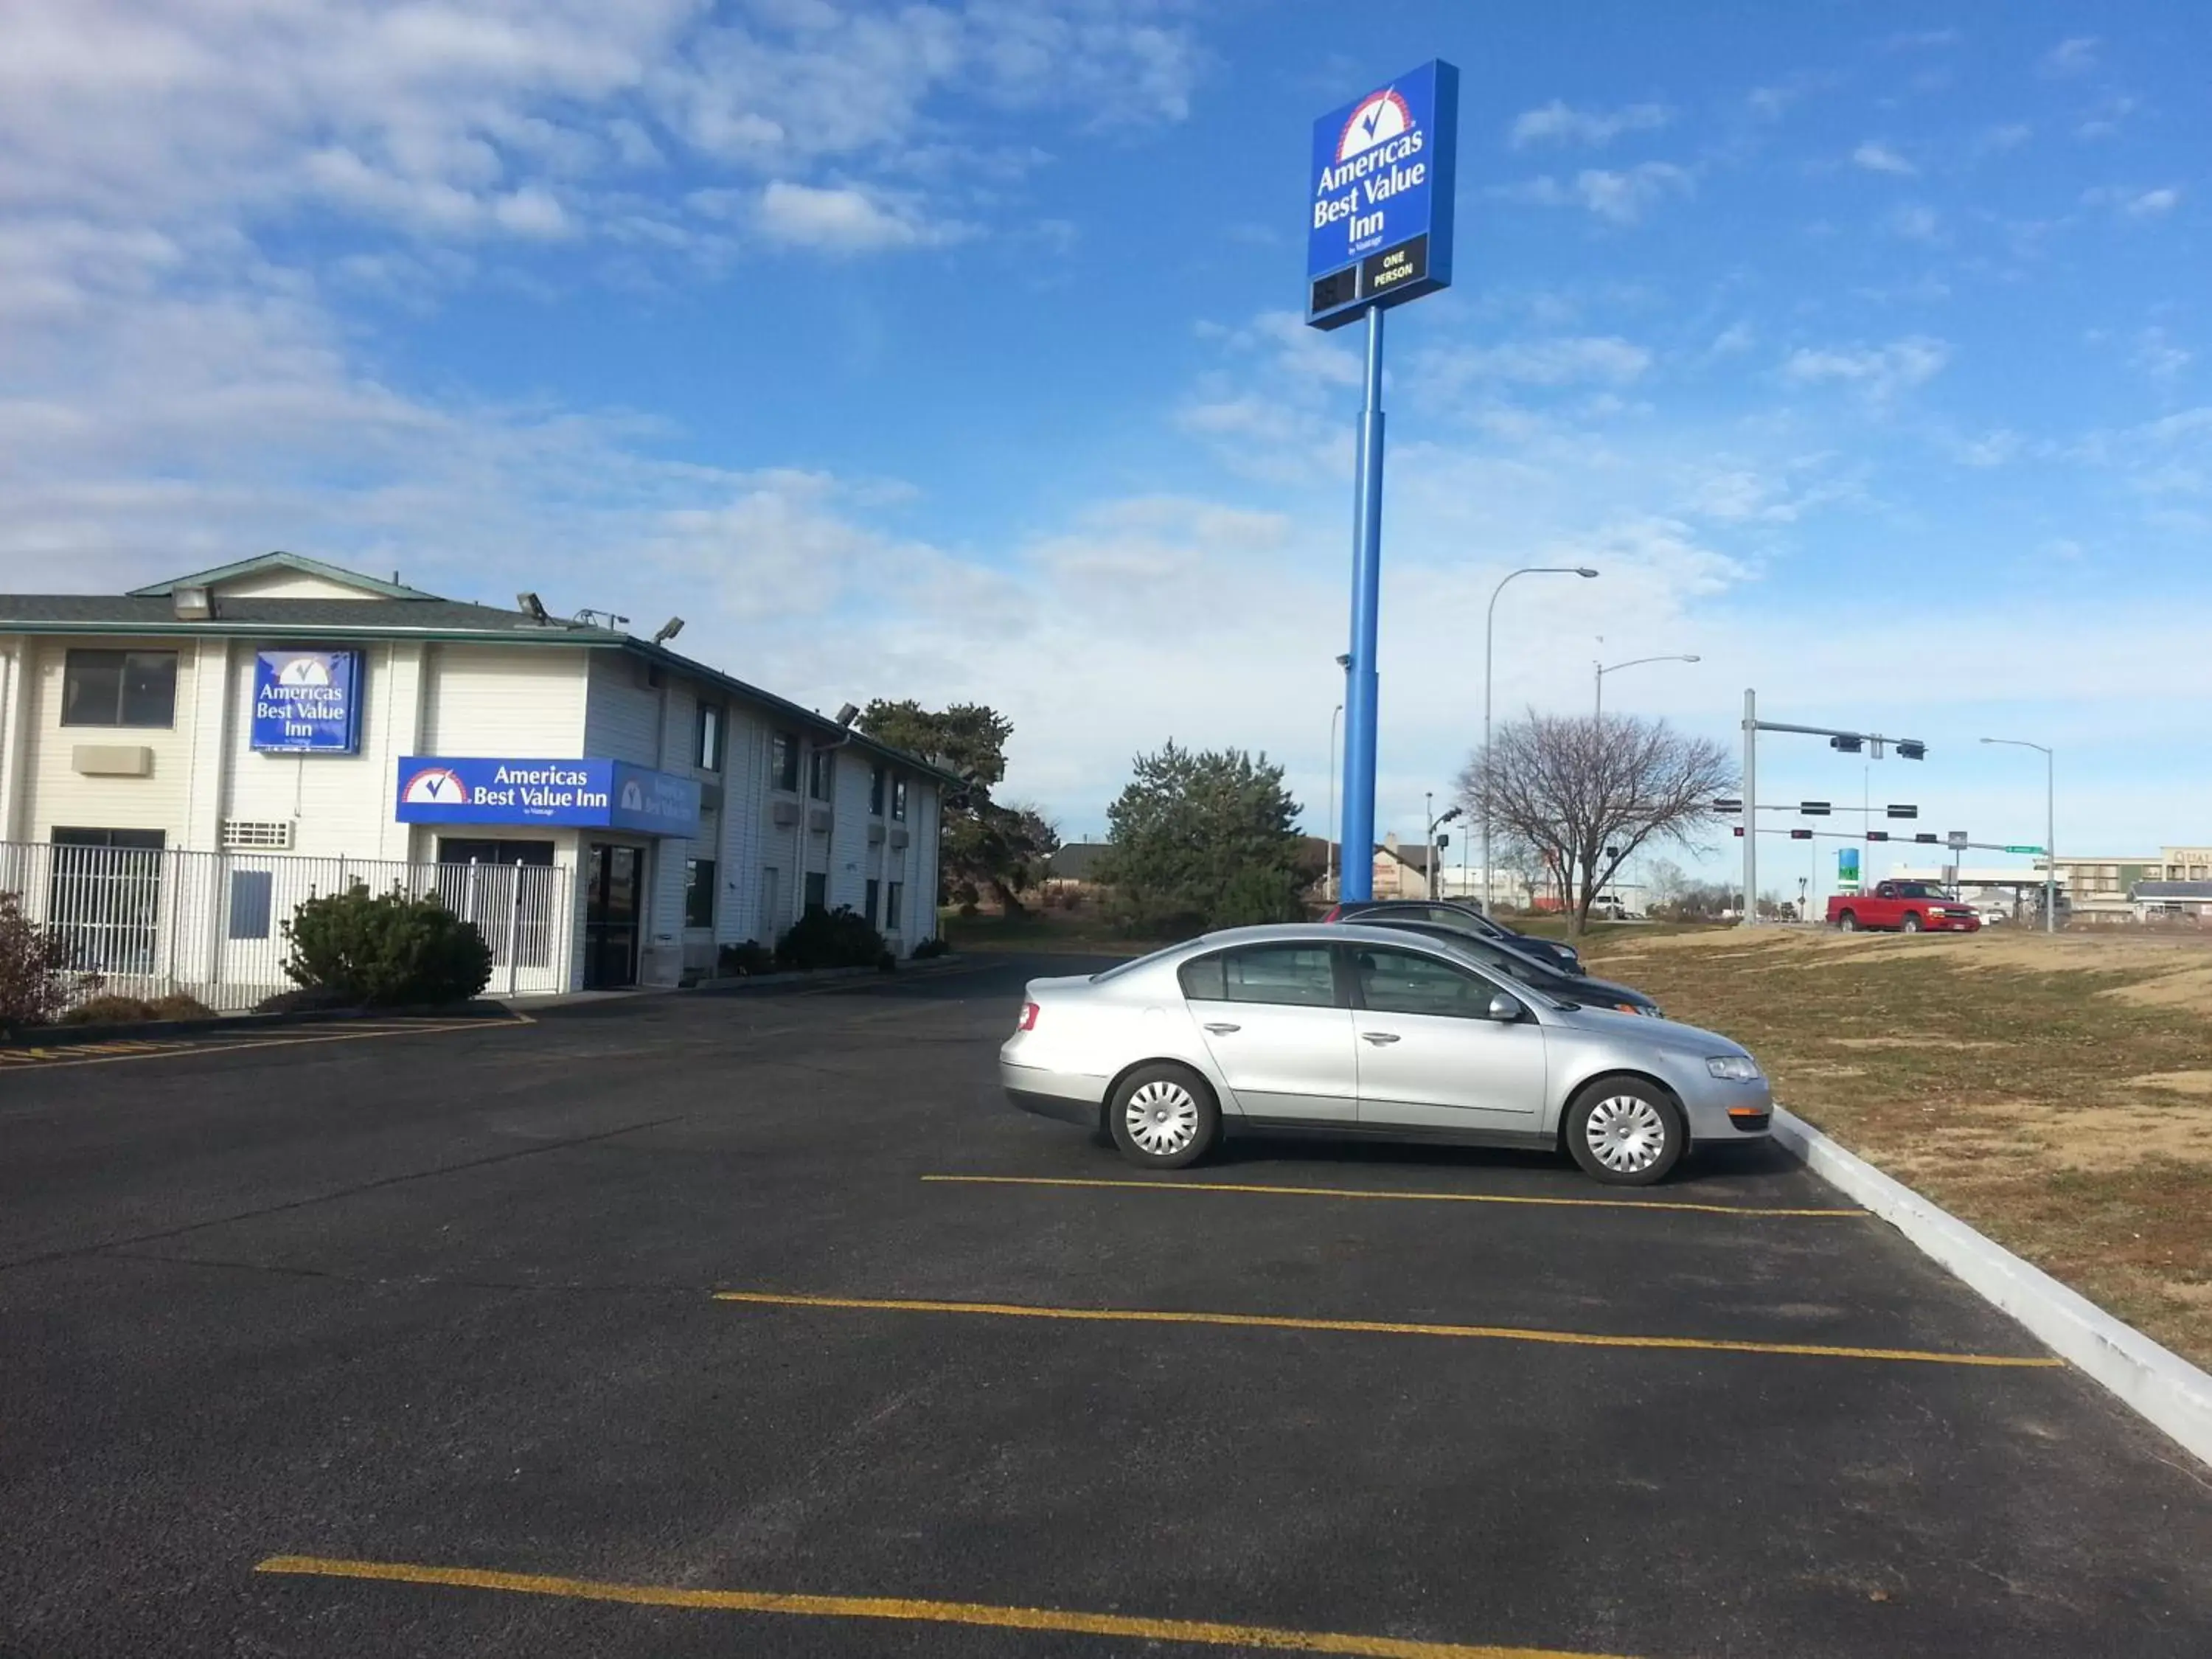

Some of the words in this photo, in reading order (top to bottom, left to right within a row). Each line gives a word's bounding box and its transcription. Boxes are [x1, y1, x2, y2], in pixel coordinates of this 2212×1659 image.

[1318, 131, 1422, 197] Americas
[1314, 187, 1358, 229] Best
[1364, 162, 1425, 204] Value
[1349, 210, 1384, 243] Inn
[1383, 251, 1405, 268] ONE
[1374, 262, 1414, 288] PERSON
[260, 684, 342, 700] Americas
[257, 702, 292, 719] Best
[297, 702, 344, 720] Value
[285, 721, 312, 737] Inn
[494, 765, 588, 786] Americas
[474, 787, 515, 805] Best
[521, 786, 572, 806] Value
[577, 789, 607, 807] Inn
